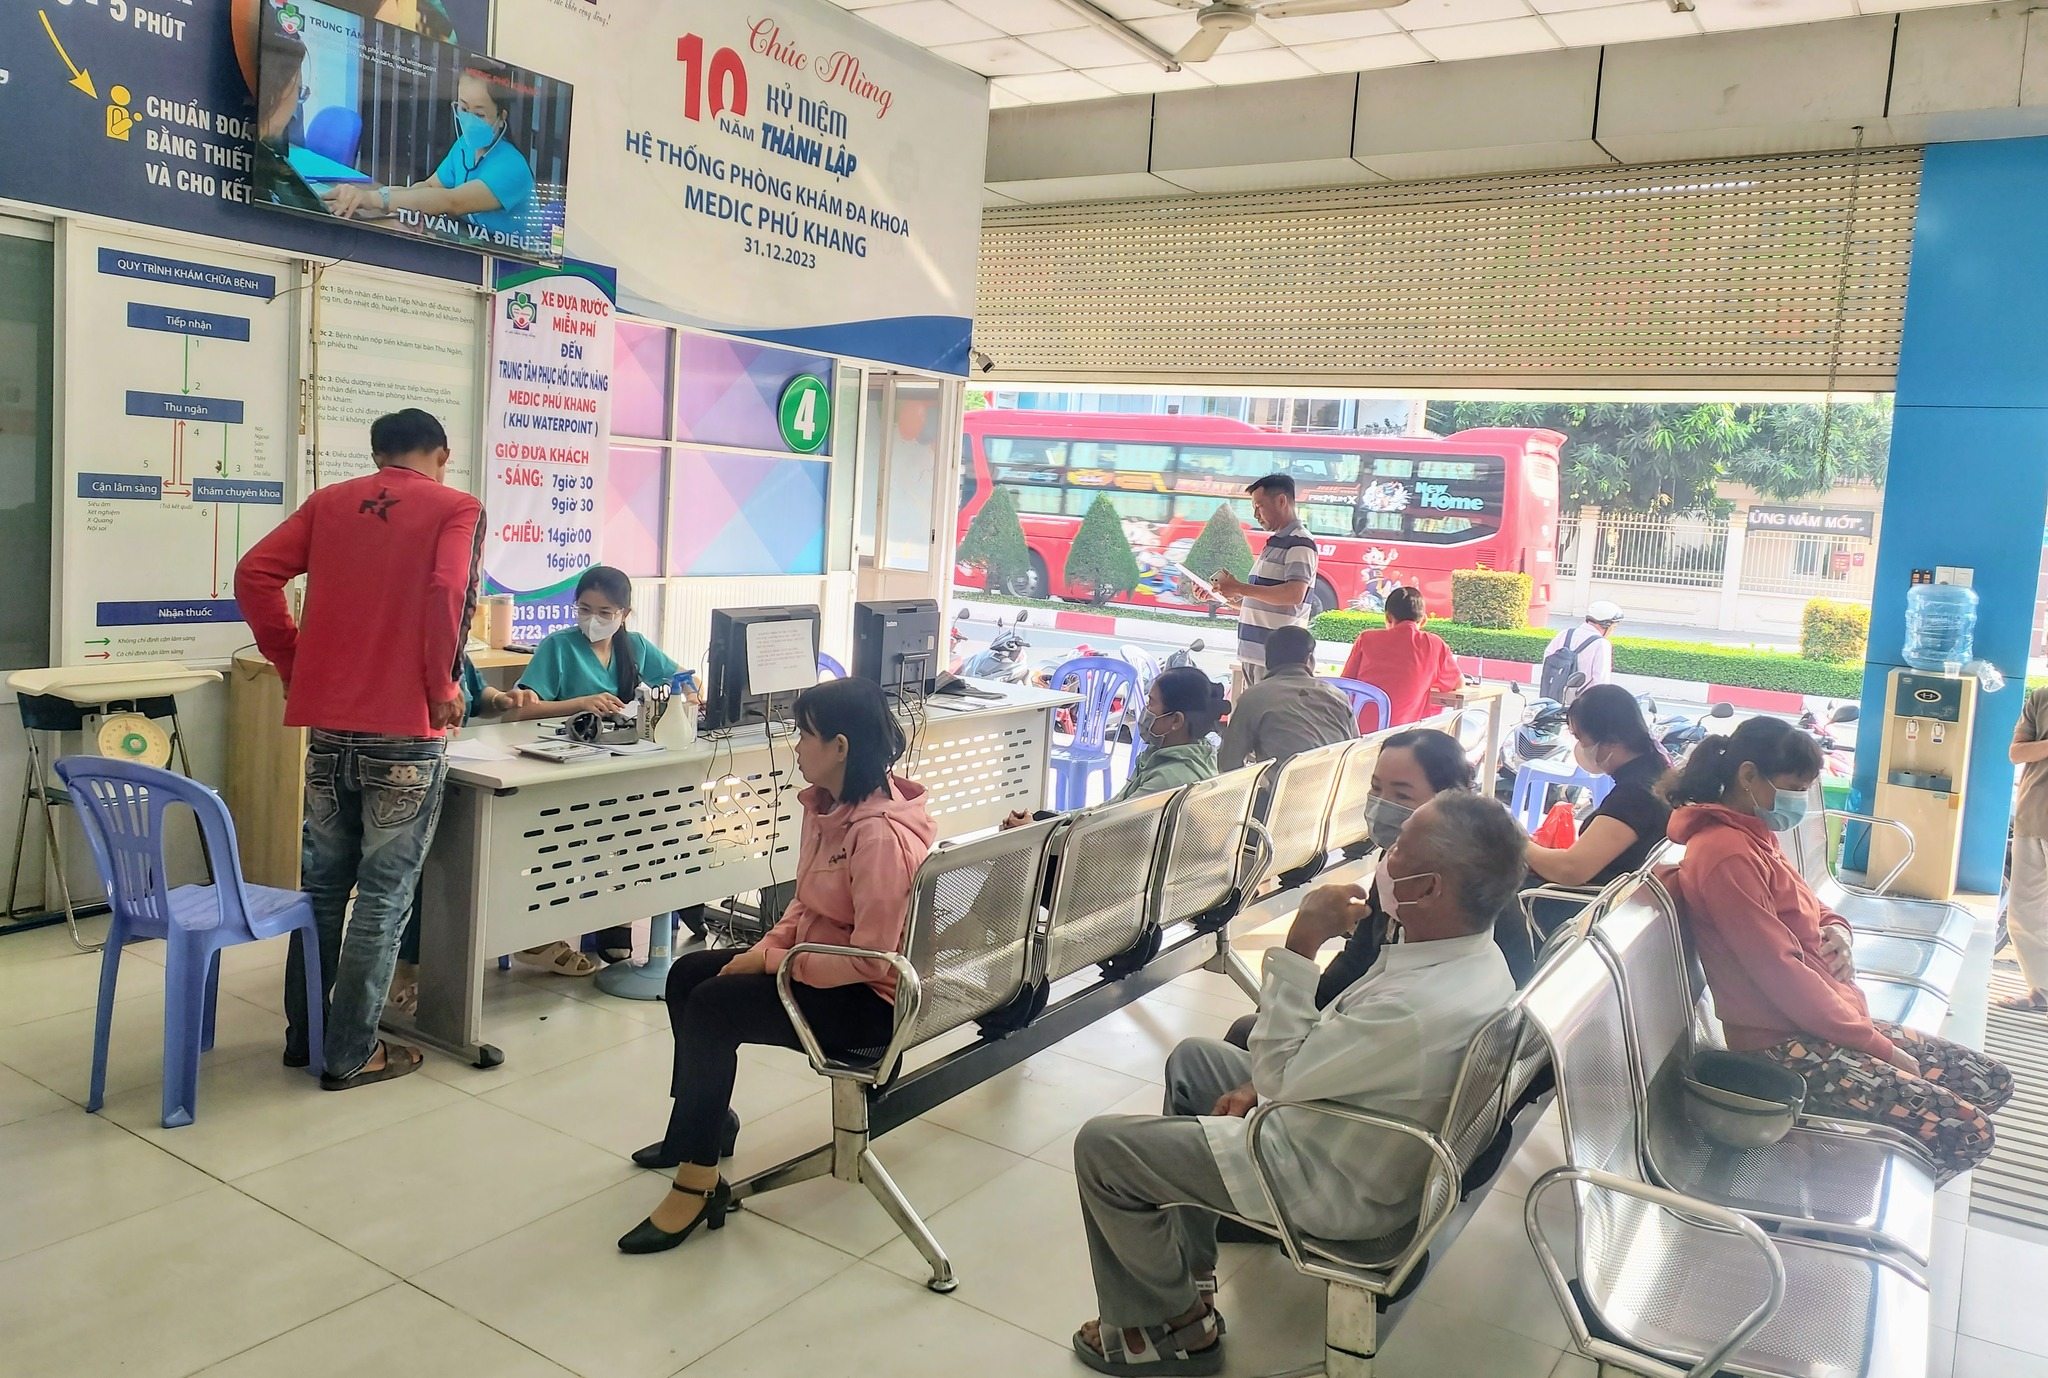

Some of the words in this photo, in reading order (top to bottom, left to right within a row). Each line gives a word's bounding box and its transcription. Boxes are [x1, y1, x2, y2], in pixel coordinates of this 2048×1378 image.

[134, 8, 186, 41] PHÚT
[309, 16, 343, 34] TRUNG
[676, 32, 748, 122] 10
[747, 15, 808, 71] Chúc
[814, 50, 895, 120] Mừng
[146, 95, 210, 130] CHUẨN
[216, 114, 254, 142] ĐOÁ
[766, 82, 793, 118] KỶ
[798, 96, 847, 140] NIỆM
[719, 117, 755, 142] NĂM
[146, 125, 197, 160] BẰNG
[202, 144, 253, 173] THIẾT
[761, 122, 823, 168] THÀNH
[824, 144, 857, 183] LẬP
[145, 161, 171, 188] VÀ
[177, 170, 216, 197] CHO
[221, 178, 253, 204] KẾT
[625, 129, 652, 163] HỆ
[657, 139, 725, 181] THỐNG
[730, 164, 791, 201] PHÒNG
[796, 184, 842, 217] KHÁM
[846, 202, 867, 225] ĐA
[870, 209, 910, 237] KHOA
[397, 207, 420, 226] TƯ
[424, 211, 459, 235] VẤN
[467, 222, 490, 242] VÀ
[684, 184, 753, 227] MEDIC
[758, 203, 799, 239] PHÚ
[803, 220, 867, 258] KHANG
[744, 237, 817, 269] 31.12.2023
[117, 258, 141, 272] QUY
[142, 263, 172, 278] TRÌNH
[174, 268, 203, 282] KHÁM
[205, 273, 232, 286] CHỮA
[234, 278, 259, 290] BỆNH
[541, 290, 555, 308] XE
[557, 293, 578, 312] ĐƯA
[580, 297, 609, 317] RƯỚC
[165, 315, 186, 328] Tiếp
[188, 320, 212, 332] nhận
[552, 312, 578, 336] MIỄN
[580, 320, 597, 338] PHÍ
[561, 340, 583, 360] ĐẾN
[195, 382, 201, 390] 2
[499, 360, 522, 381] TRUNG
[524, 359, 538, 383] TÂM
[538, 367, 556, 389] PHỤC
[557, 363, 570, 386] HỒI
[570, 367, 589, 390] CHỨC
[589, 369, 608, 391] NĂNG
[164, 402, 183, 413] Thu
[184, 404, 208, 416] ngân
[508, 389, 540, 407] MEDIC
[542, 392, 562, 409] PHÚ
[563, 396, 596, 413] KHANG
[508, 413, 530, 428] KHU
[532, 415, 593, 434] WATERPOINT
[794, 388, 817, 441] 4
[194, 429, 200, 437] 4
[143, 460, 149, 468] 5
[495, 441, 520, 459] GIỜ
[521, 445, 547, 462] ĐƯA
[549, 446, 589, 464] KHÁCH
[235, 465, 241, 473] 3
[505, 464, 544, 487] SÁNG:
[552, 474, 578, 492] 7giờ
[580, 476, 593, 490] 30
[92, 481, 112, 494] Cận
[114, 482, 133, 492] lâm
[134, 484, 158, 496] sàng
[197, 485, 223, 497] Khám
[225, 488, 257, 500] chuyên
[259, 488, 280, 498] khoa
[1415, 482, 1450, 494] New
[201, 509, 208, 517] 6
[551, 497, 578, 515] 9giờ
[580, 498, 594, 512] 30
[1421, 492, 1484, 511] Home
[502, 518, 544, 543] CHIỀU:
[1788, 512, 1821, 528] NĂM
[158, 608, 184, 619] Nhận
[185, 606, 213, 617] thuốc
[513, 605, 535, 620] 913
[537, 605, 560, 620] 615
[512, 625, 546, 640] 2723.
